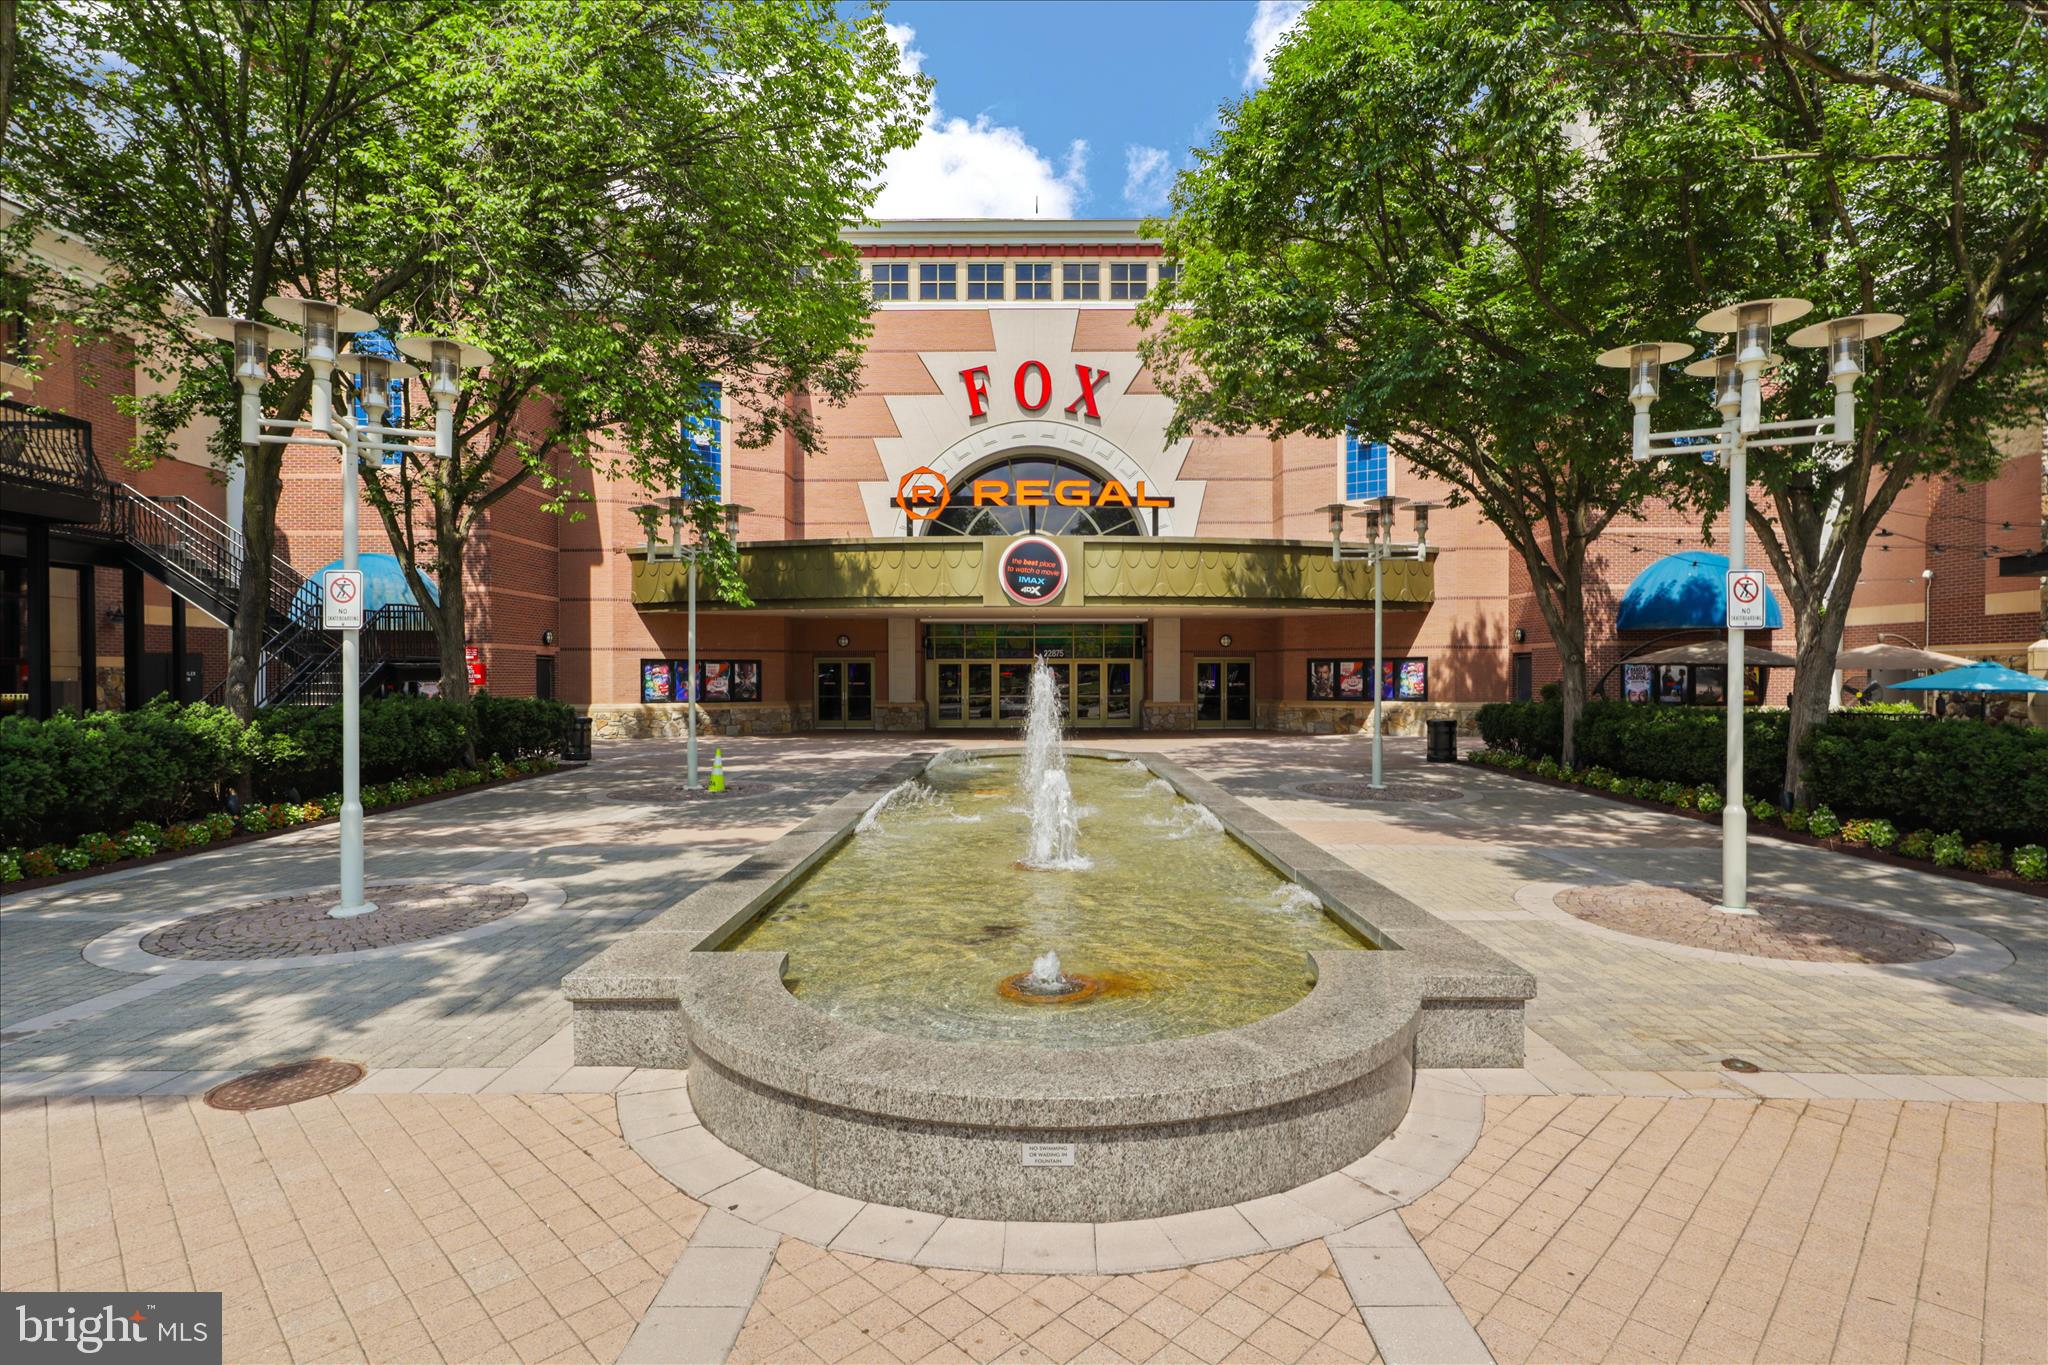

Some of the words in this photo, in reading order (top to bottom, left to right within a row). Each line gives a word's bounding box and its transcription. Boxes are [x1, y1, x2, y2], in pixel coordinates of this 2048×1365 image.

[959, 360, 1110, 419] FOX
[973, 480, 1170, 507] REGAL
[1018, 576, 1045, 585] IMAX
[1020, 586, 1041, 596] 4DX
[1043, 649, 1064, 657] 22875
